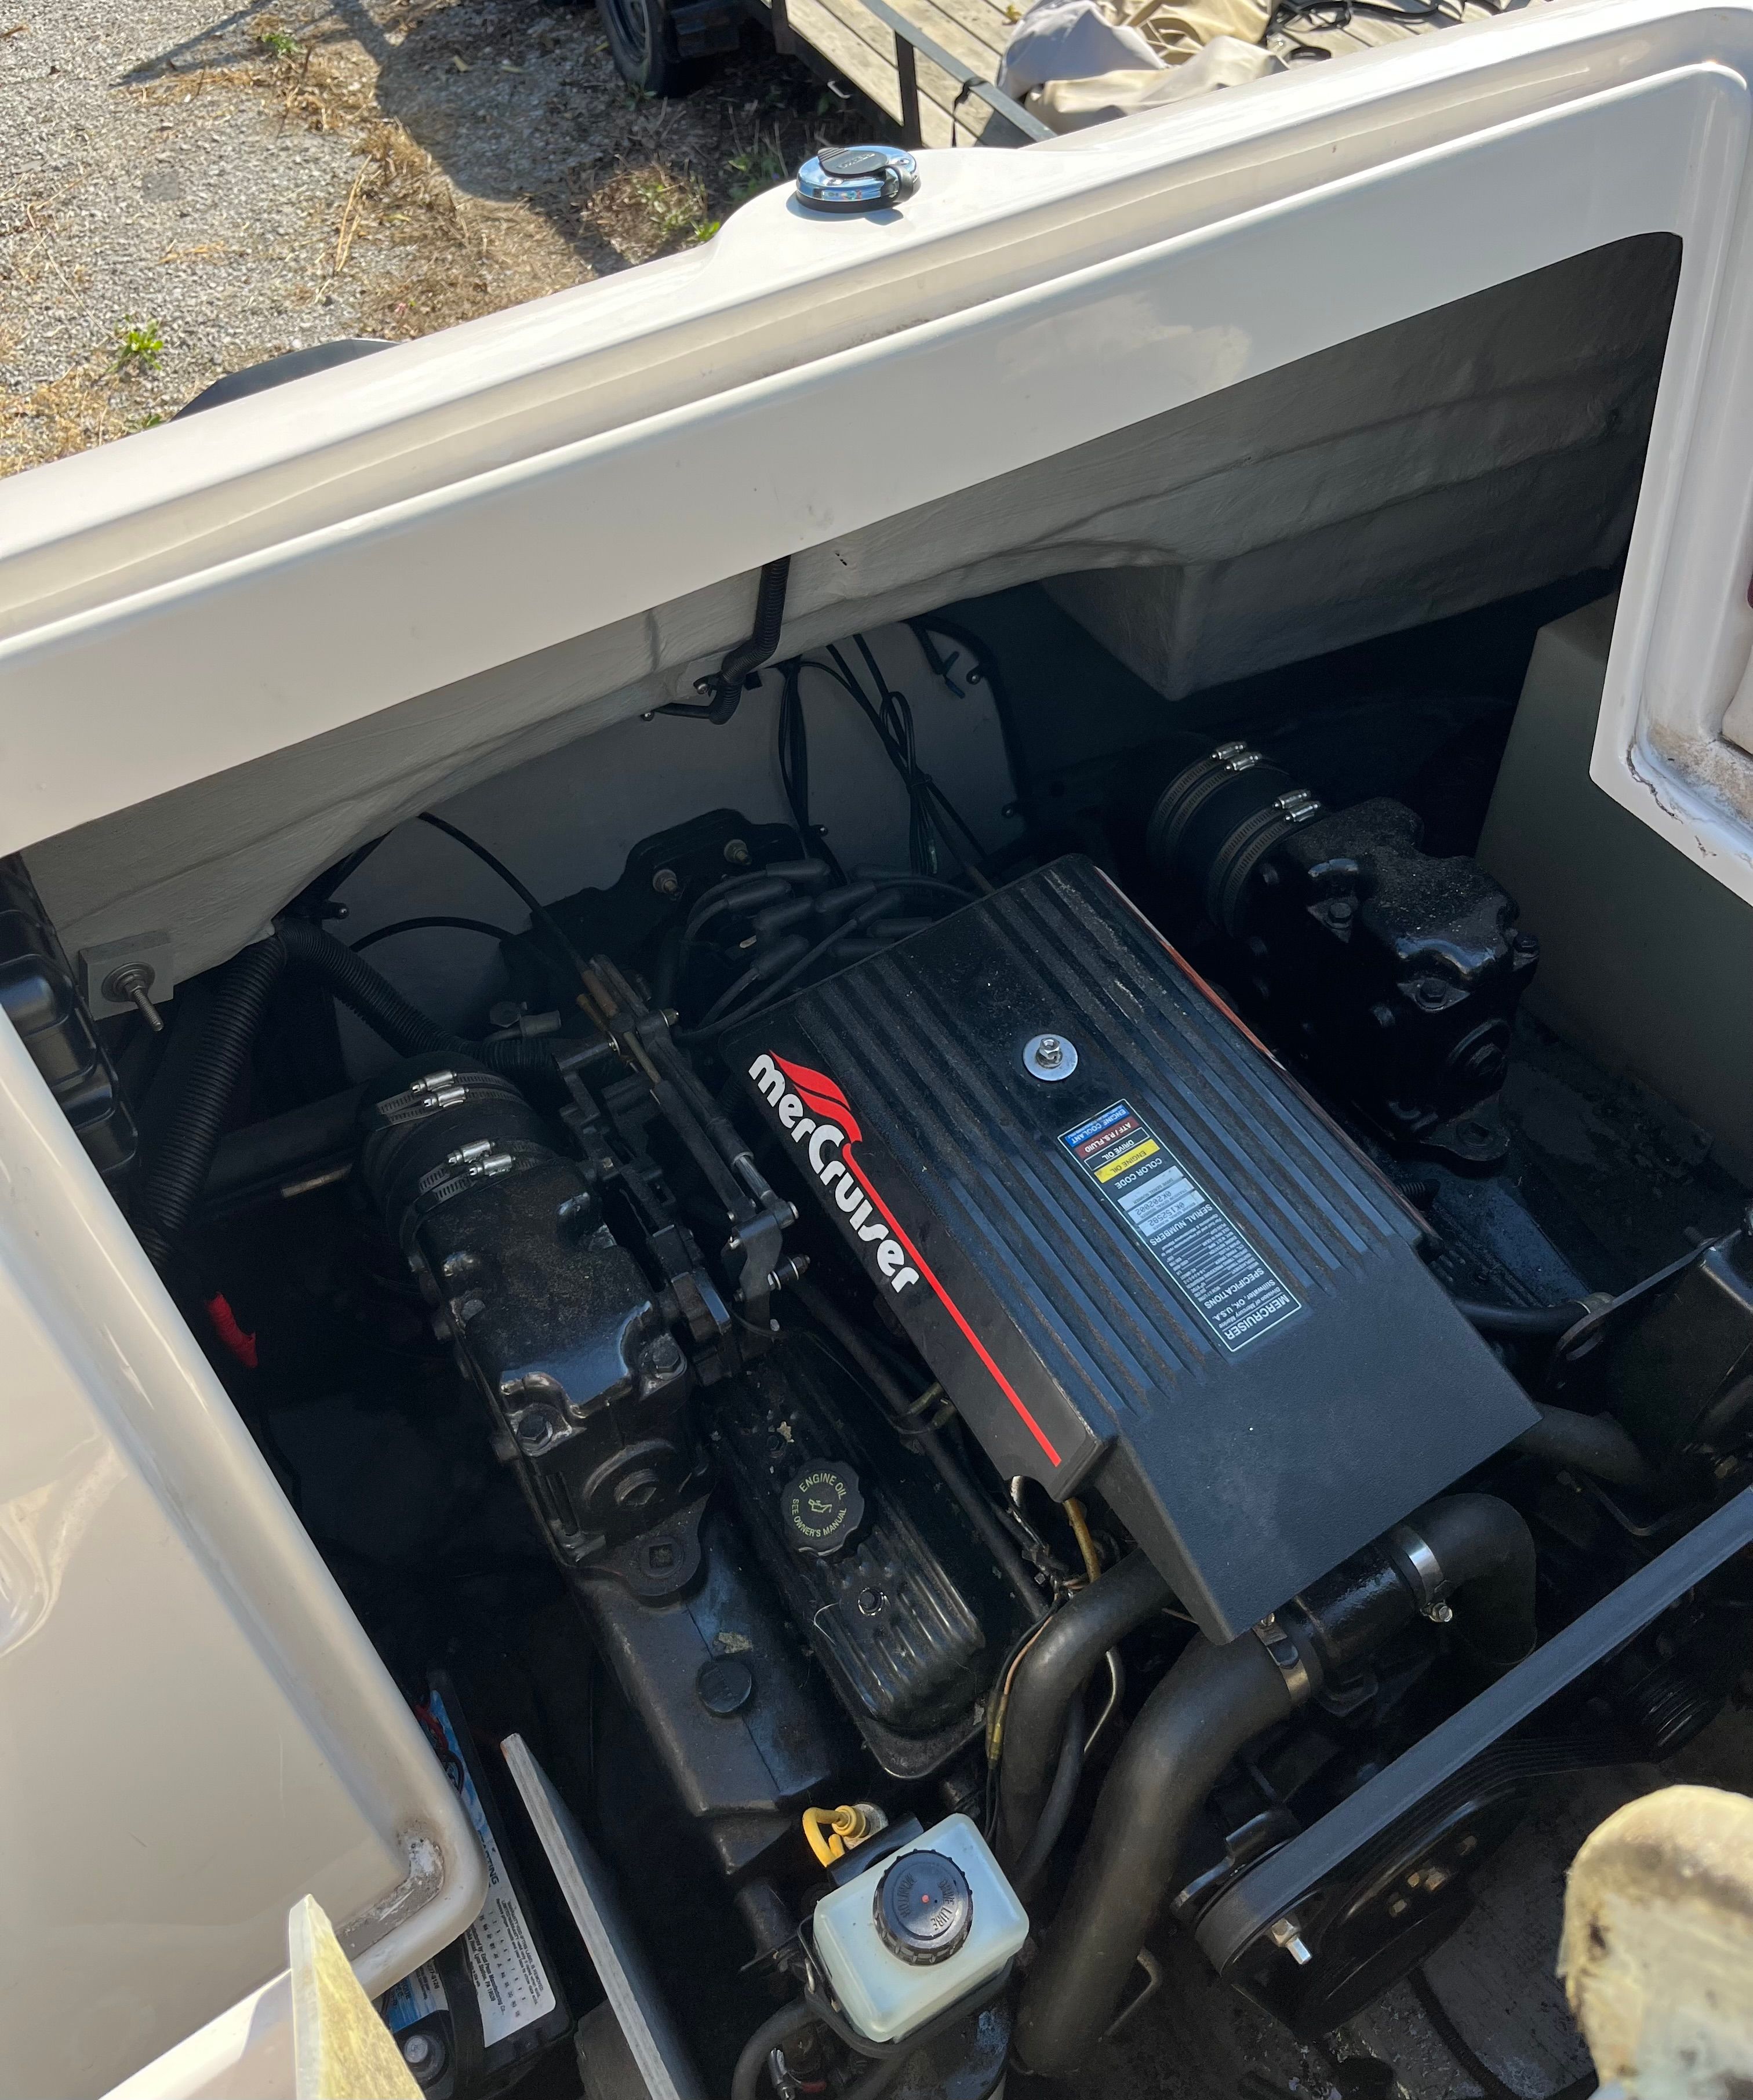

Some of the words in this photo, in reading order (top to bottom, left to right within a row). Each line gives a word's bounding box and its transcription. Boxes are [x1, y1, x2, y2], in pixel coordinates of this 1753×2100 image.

[1101, 1108, 1126, 1125] ENGINE
[1070, 1122, 1102, 1144] COOLANT
[1116, 1122, 1132, 1133] ATF
[1112, 1138, 1134, 1153] DRIVE
[1101, 1150, 1115, 1161] OIL
[1121, 1150, 1147, 1167] ENGINE
[1109, 1164, 1122, 1174] OIL
[1134, 1157, 1163, 1177] COLOR
[1114, 1172, 1137, 1189] CODE
[1134, 1189, 1172, 1215] 0K202002
[1184, 1203, 1213, 1224] SERIAL
[1148, 1219, 1187, 1246] NUMBERS
[1203, 1266, 1264, 1309] SPECIFICATIONS
[1242, 1276, 1275, 1302] Stillwater,
[1259, 1286, 1281, 1302] Division
[1230, 1297, 1246, 1310] OK,
[1233, 1301, 1256, 1319] Mercury
[1211, 1306, 1233, 1323] U.S.A.
[1217, 1315, 1236, 1329] Marine
[1223, 1293, 1290, 1341] MERCRUISER
[799, 1473, 837, 1493] ENGINE
[835, 1483, 847, 1500] OIL
[794, 1516, 821, 1537] OWNER'S
[823, 1508, 847, 1535] MANUAL
[937, 1878, 954, 1905] DRIVE
[930, 1906, 952, 1930] LUBE
